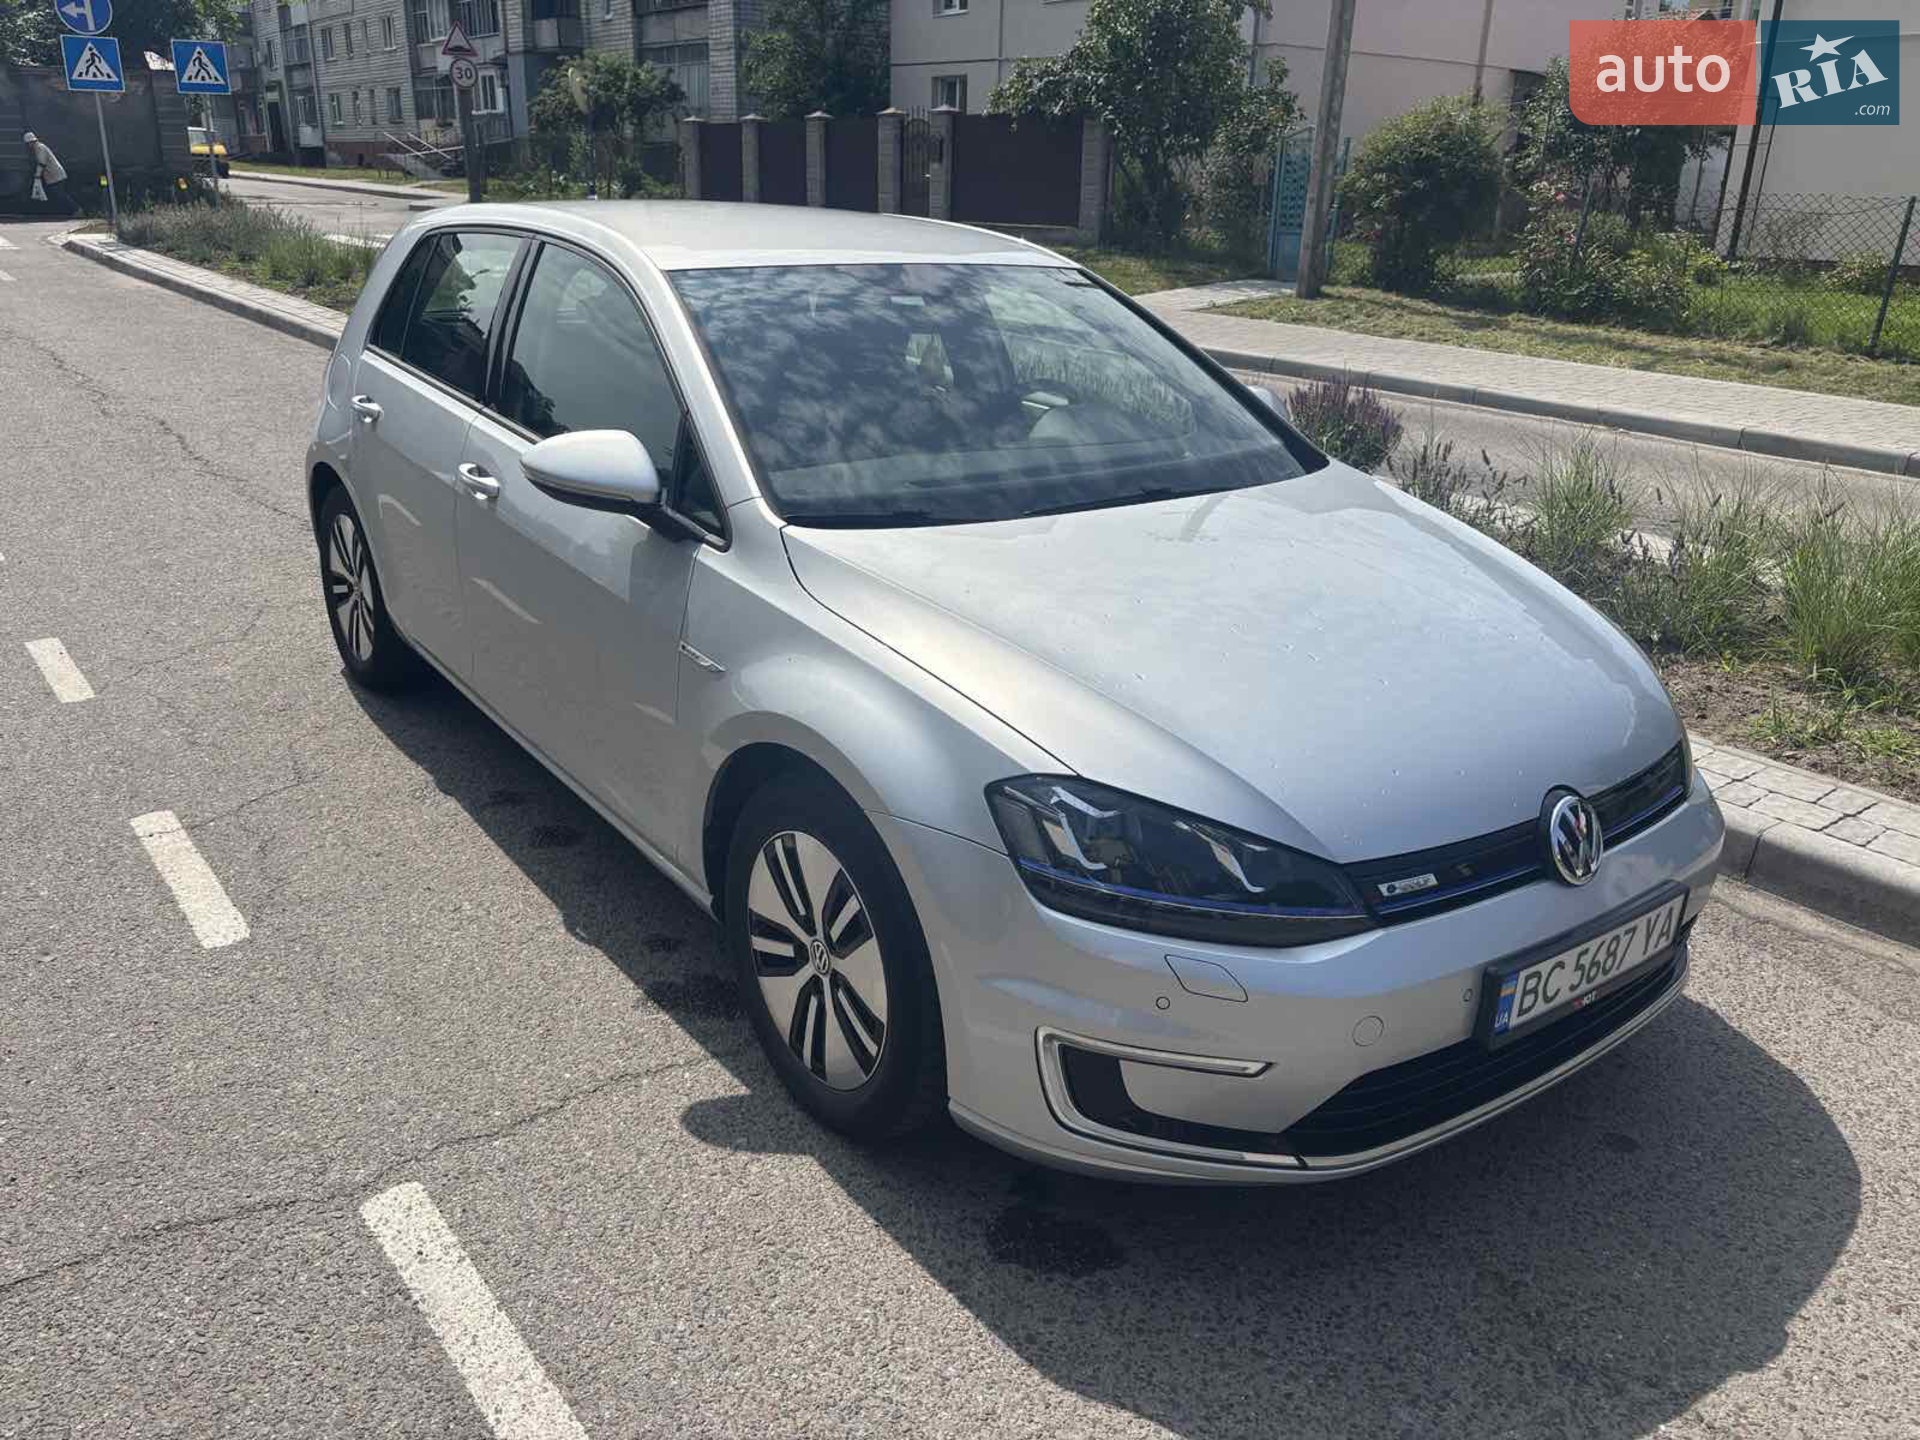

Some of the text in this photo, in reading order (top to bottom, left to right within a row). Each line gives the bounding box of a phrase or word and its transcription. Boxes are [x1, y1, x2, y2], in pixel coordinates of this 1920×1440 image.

[455, 66, 473, 79] 30
[1516, 906, 1674, 1018] BC 5687 YA
[1494, 1011, 1509, 1028] UA
